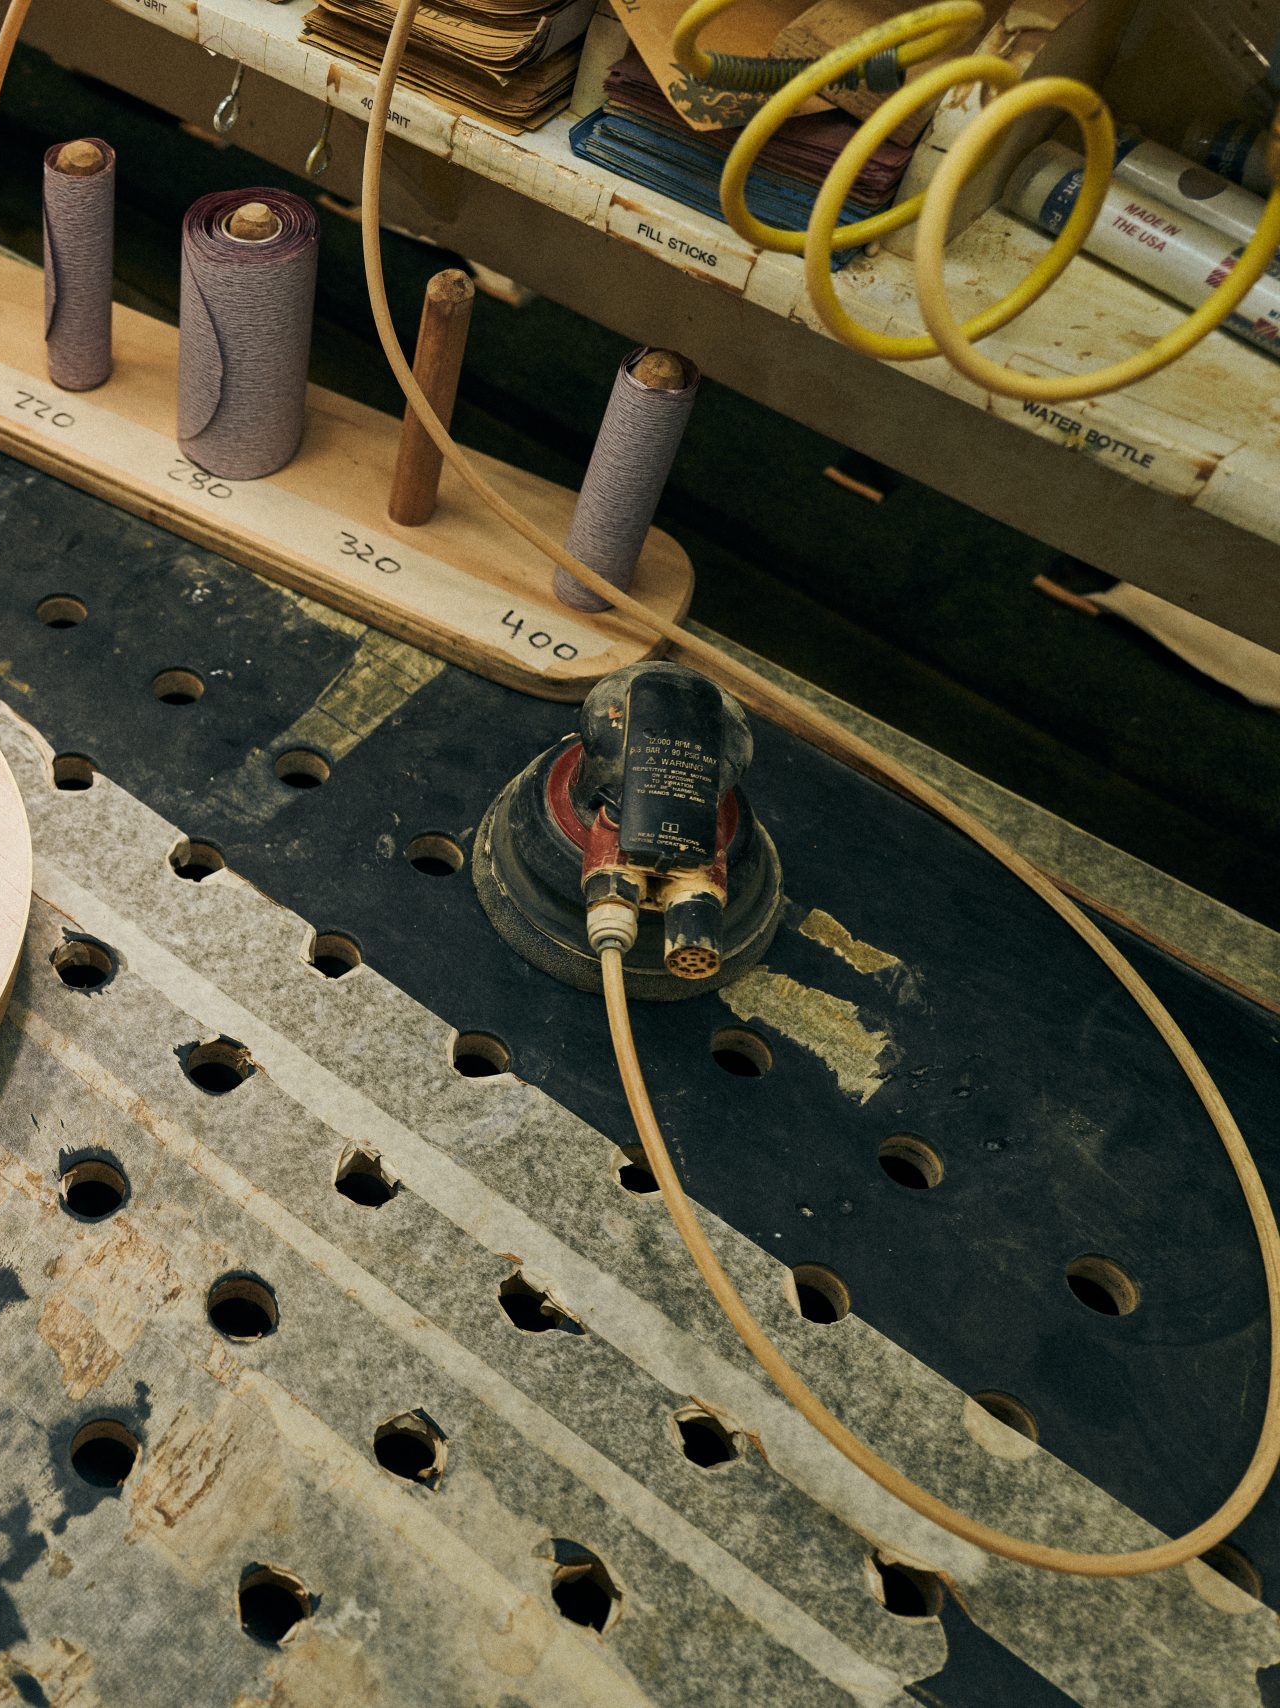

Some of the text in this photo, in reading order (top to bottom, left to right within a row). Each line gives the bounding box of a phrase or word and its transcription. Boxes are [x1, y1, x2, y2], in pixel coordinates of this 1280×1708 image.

[143, 0, 168, 15] GRIT
[1112, 216, 1167, 252] THE USA
[1124, 203, 1182, 236] MADE IN
[637, 223, 717, 267] FILL STICKS
[13, 390, 76, 428] 220
[1023, 401, 1155, 469] WATER BOTTLE
[167, 458, 233, 500] 280
[339, 531, 402, 574] 320
[501, 609, 579, 661] 400
[645, 746, 660, 754] BAR
[661, 758, 704, 772] WARNING
[658, 834, 700, 847] INSTRUCTIONS
